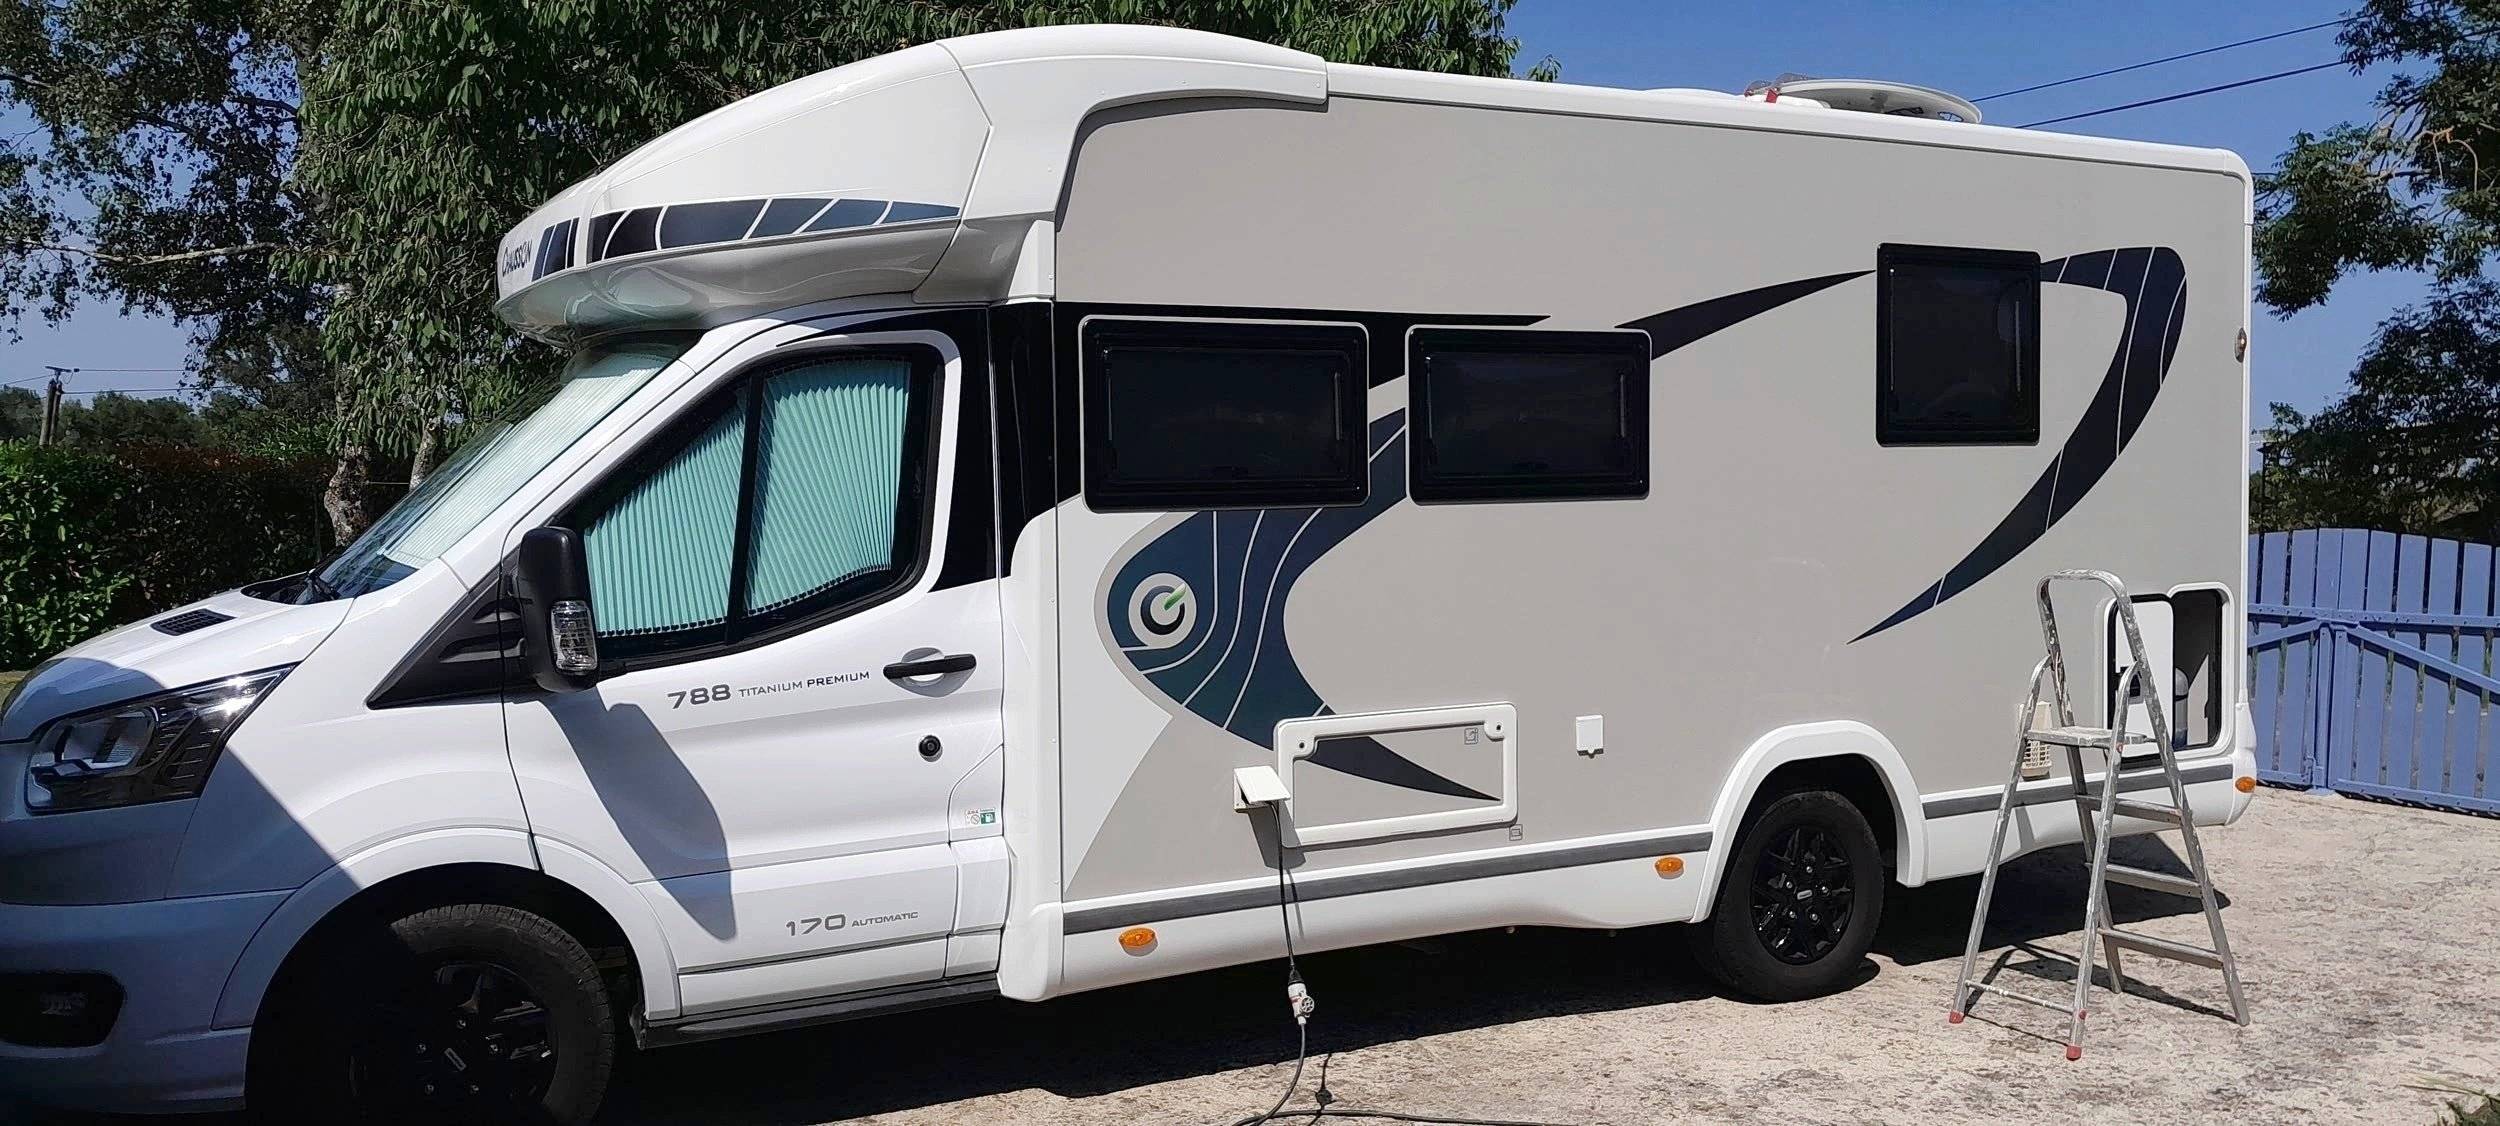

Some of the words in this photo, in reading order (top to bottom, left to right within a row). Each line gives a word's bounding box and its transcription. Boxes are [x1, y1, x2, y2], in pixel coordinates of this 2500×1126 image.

[667, 684, 731, 709] 788
[739, 681, 803, 697] TITANIUM
[807, 671, 870, 688] PREMIUM
[786, 914, 846, 936] 170
[851, 911, 919, 927] AUTOMATIC
